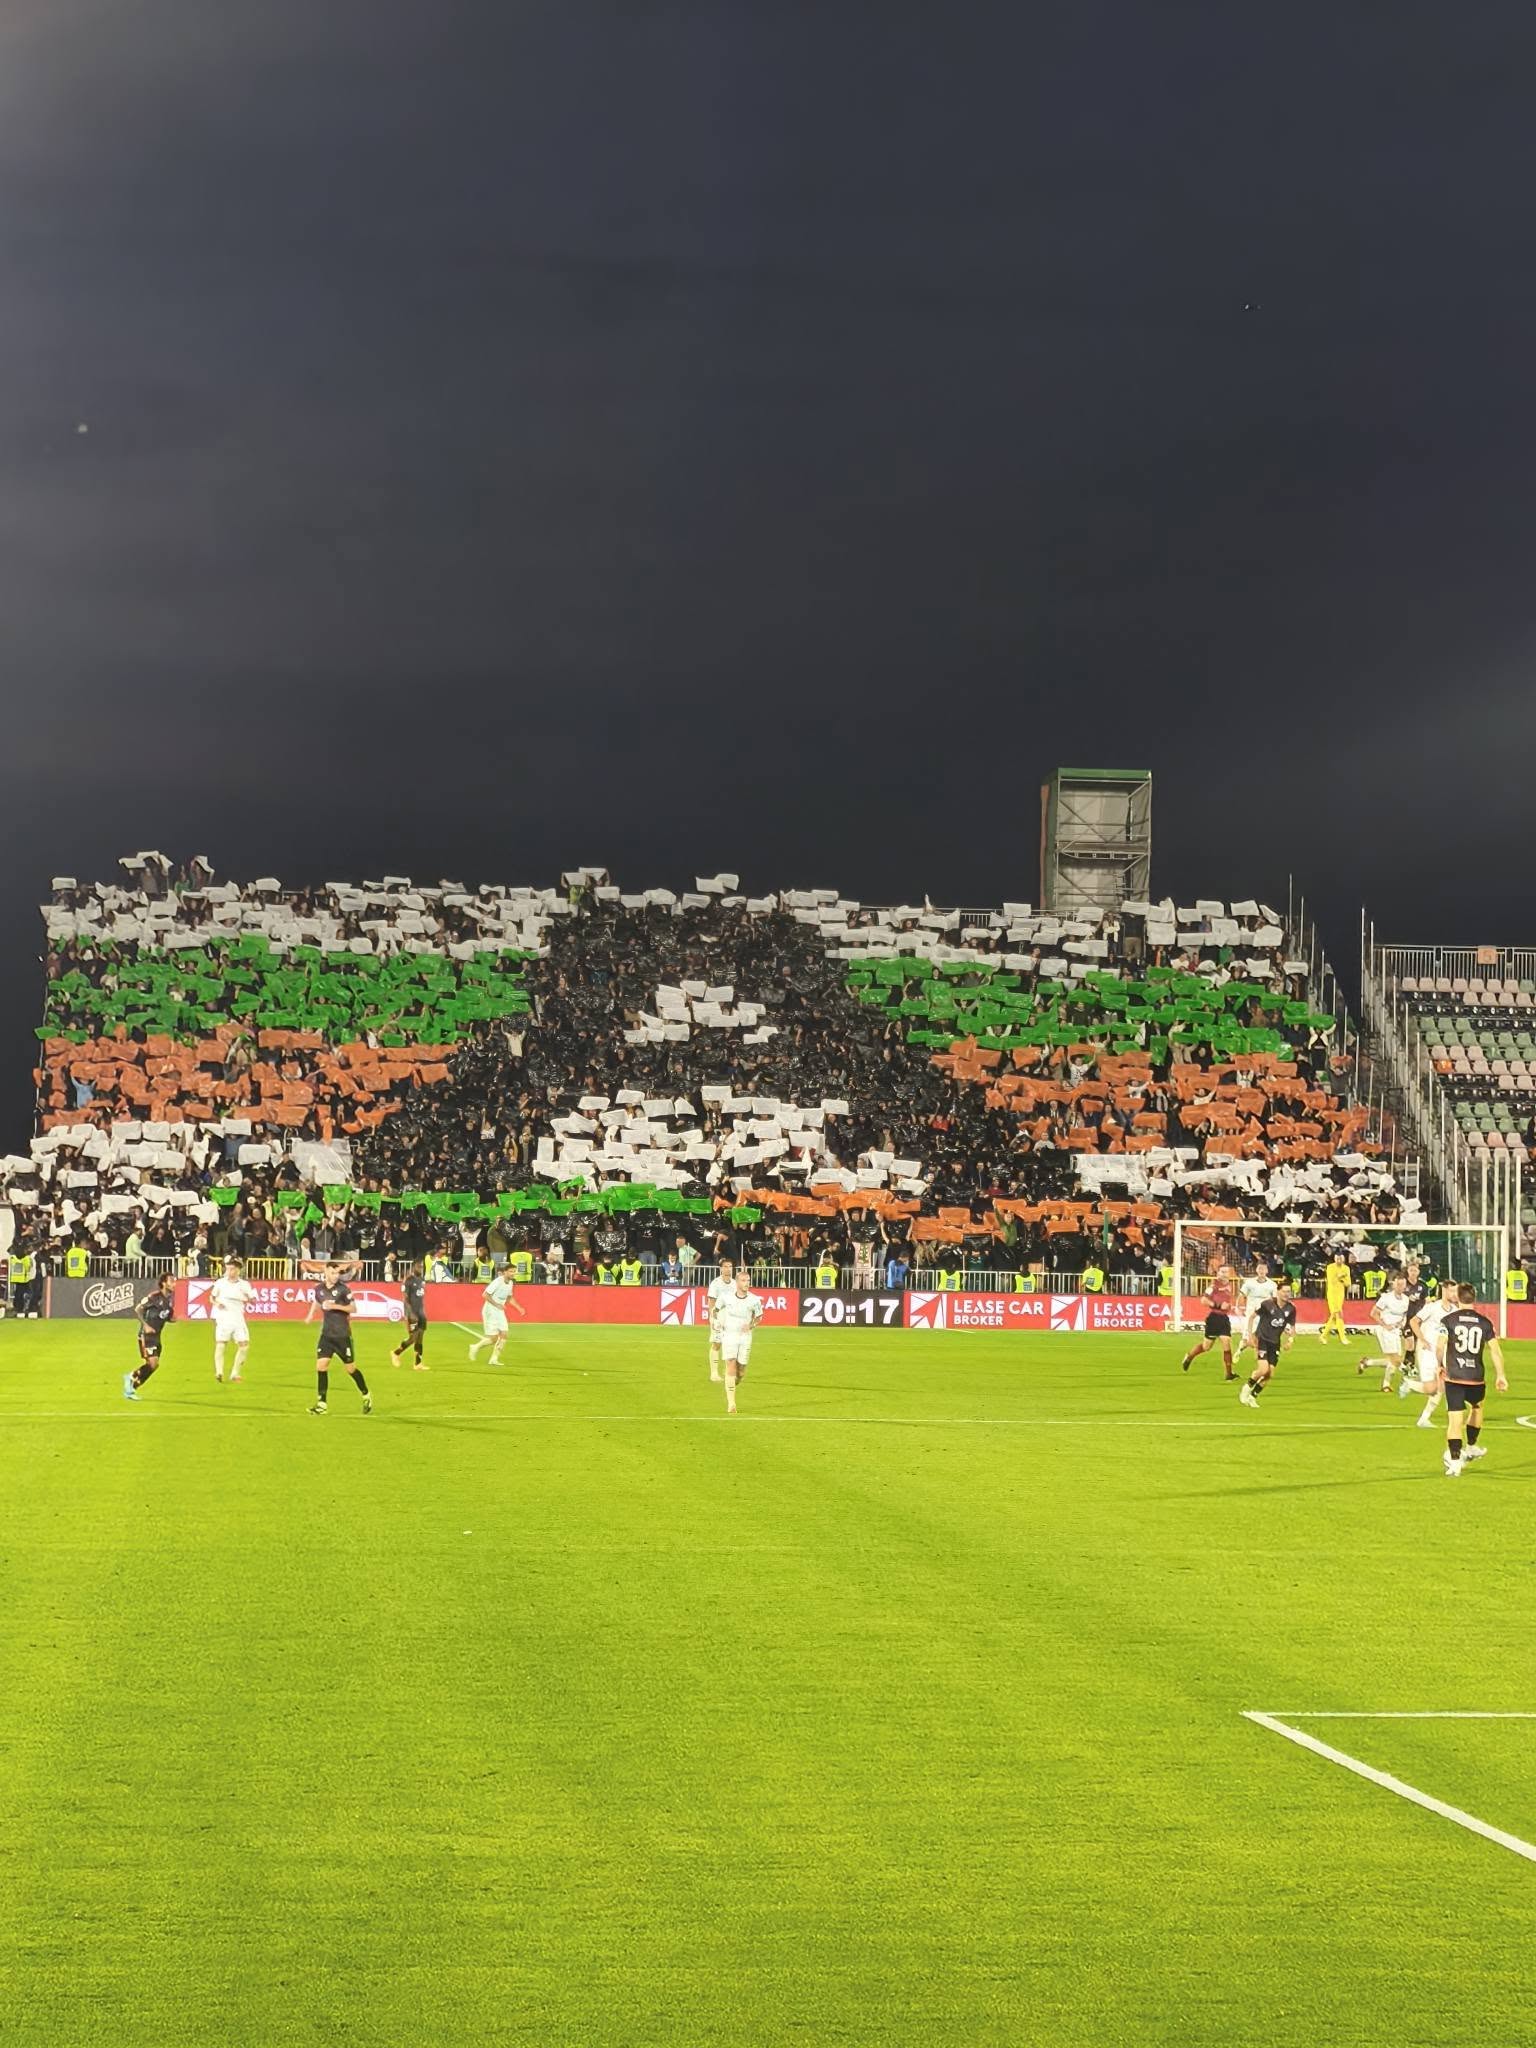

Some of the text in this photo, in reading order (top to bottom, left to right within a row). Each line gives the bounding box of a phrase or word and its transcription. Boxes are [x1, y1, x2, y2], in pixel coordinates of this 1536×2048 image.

[253, 1288, 316, 1303] ASE CAR
[246, 1303, 278, 1313] OKER
[802, 1297, 900, 1324] 20:17
[954, 1300, 1044, 1315] LEASE CAR
[1094, 1303, 1183, 1317] LEASE CA
[954, 1315, 1003, 1326] BROKER
[1094, 1318, 1143, 1328] BROKER
[1455, 1325, 1482, 1354] 30
